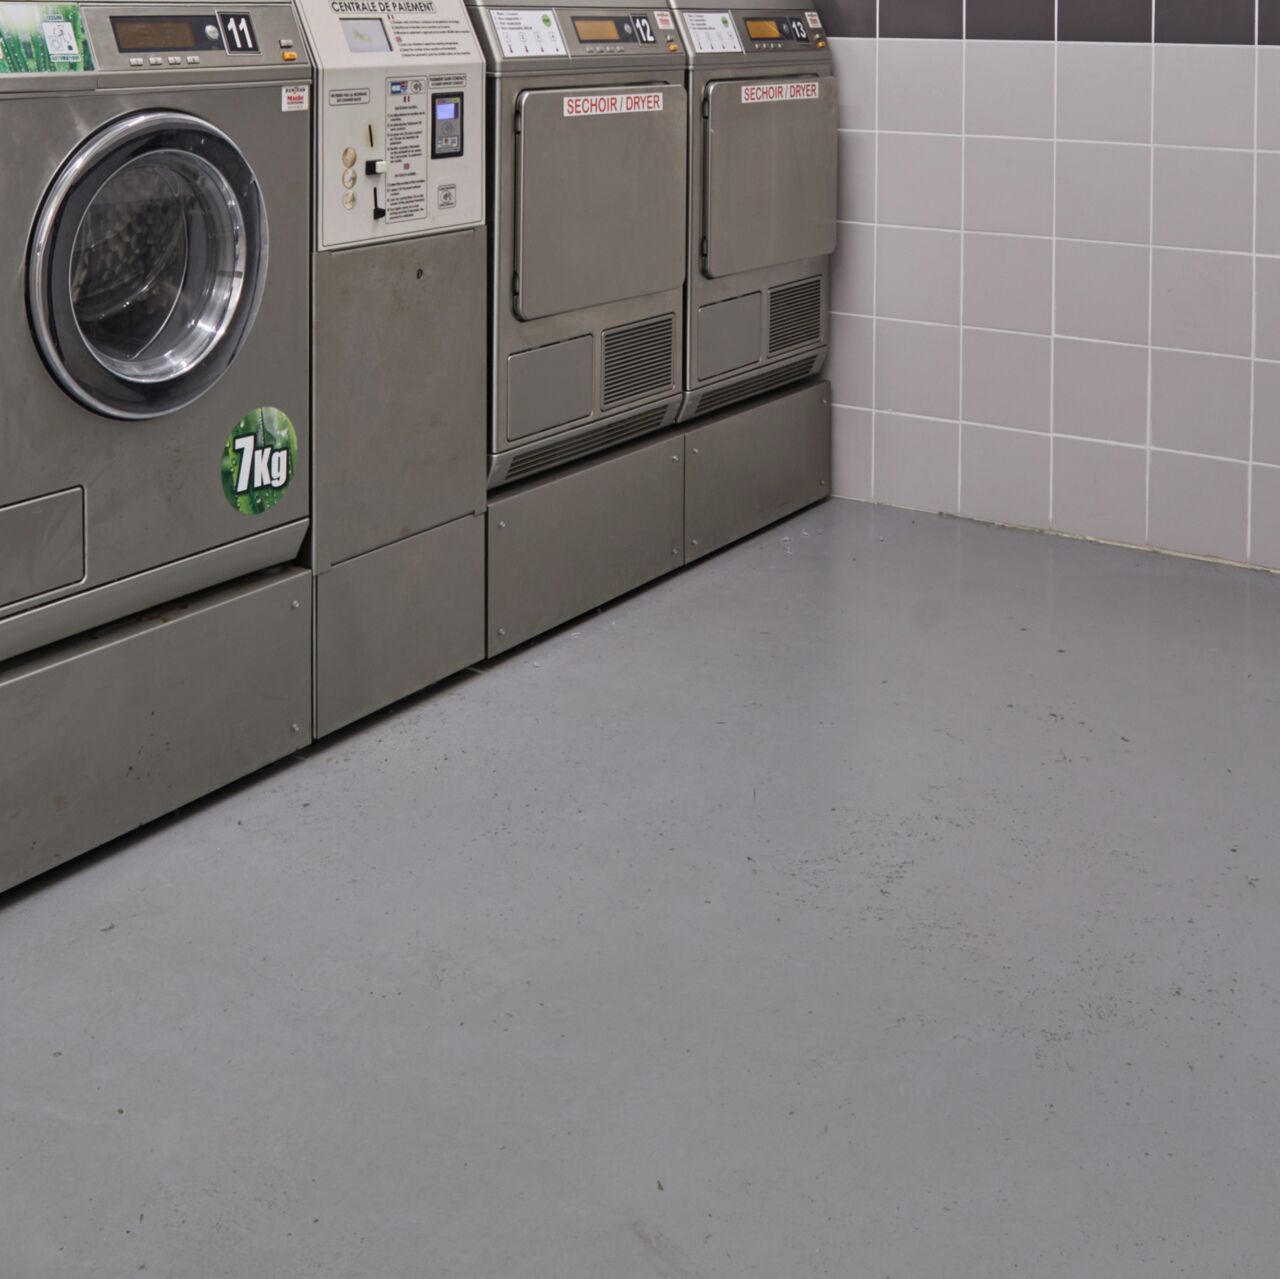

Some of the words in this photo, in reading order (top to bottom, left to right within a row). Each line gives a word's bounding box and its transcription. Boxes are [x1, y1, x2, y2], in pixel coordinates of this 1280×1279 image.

[331, 1, 378, 12] CENTRALE
[380, 1, 389, 12] DE
[392, 1, 434, 12] PAIEMENT
[227, 18, 253, 49] 11
[636, 18, 655, 42] 12
[792, 21, 806, 38] 13
[744, 86, 783, 101] SECHOIR
[789, 84, 816, 98] DRYER
[567, 97, 617, 114] SECHOIR
[626, 95, 660, 111] DRYER
[235, 435, 288, 493] 7Kg
